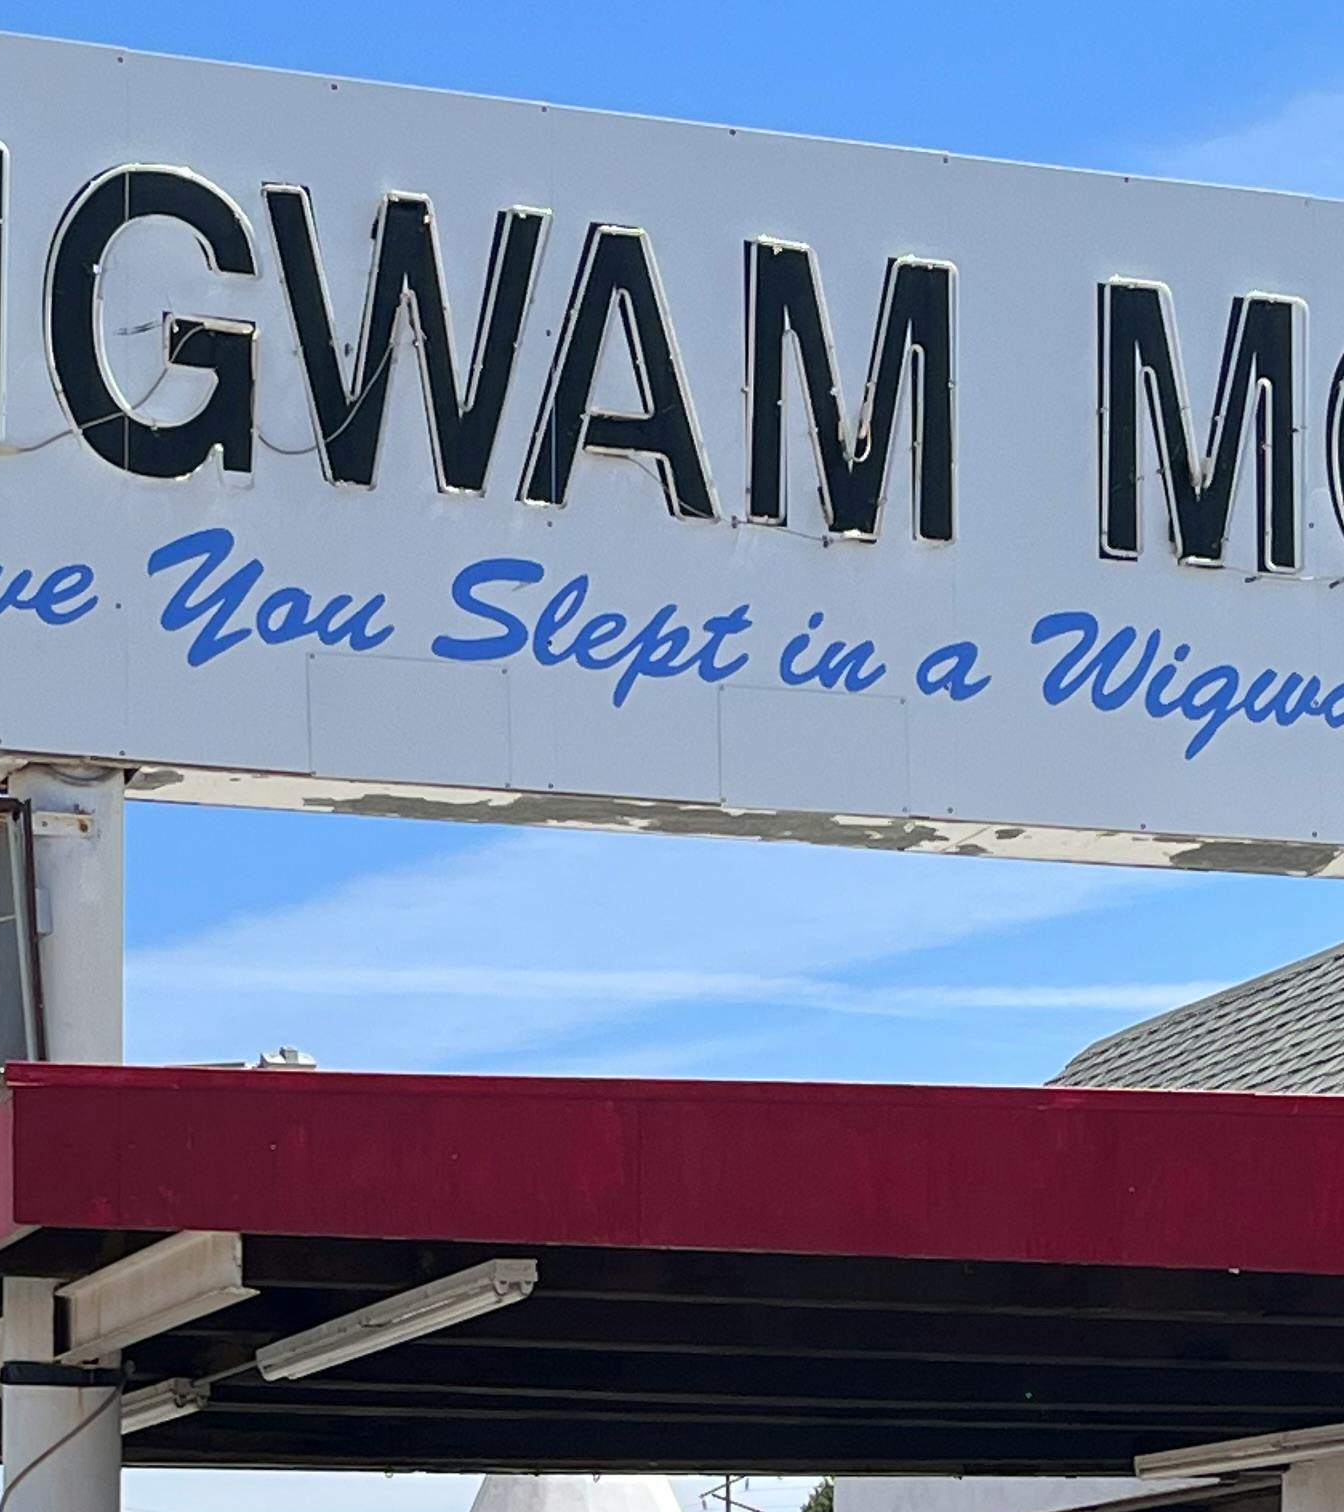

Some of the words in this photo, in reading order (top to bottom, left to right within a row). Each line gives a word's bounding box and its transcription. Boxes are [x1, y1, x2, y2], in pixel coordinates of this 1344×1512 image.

[147, 528, 393, 666] You
[431, 558, 752, 707] Slept
[780, 612, 885, 692] in
[916, 641, 990, 700] a
